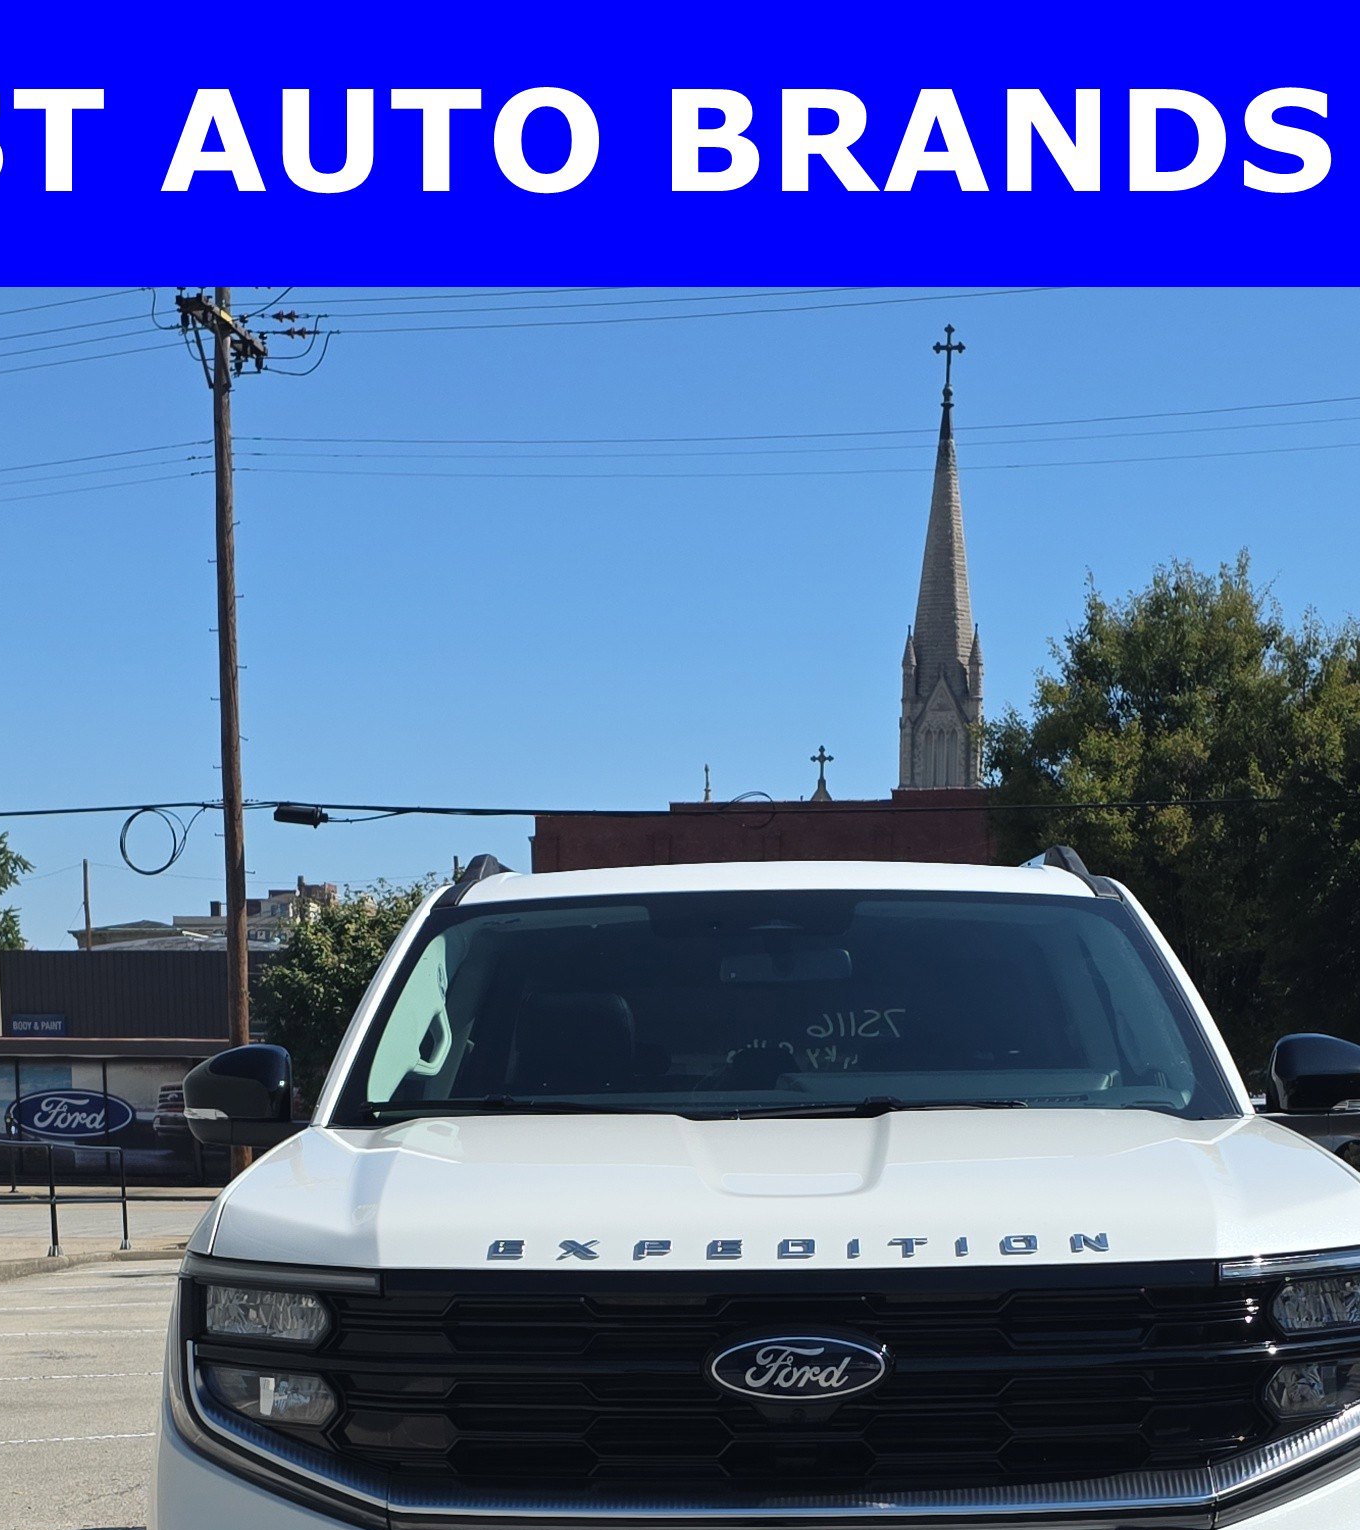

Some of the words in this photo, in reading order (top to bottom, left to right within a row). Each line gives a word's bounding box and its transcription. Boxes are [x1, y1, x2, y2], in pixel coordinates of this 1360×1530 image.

[12, 1020, 31, 1031] BODY
[33, 1021, 39, 1031] &
[41, 1020, 62, 1031] PAINT
[33, 1096, 105, 1129] Ford
[486, 1231, 1110, 1262] EXPEDITION
[744, 1345, 852, 1388] Ford
